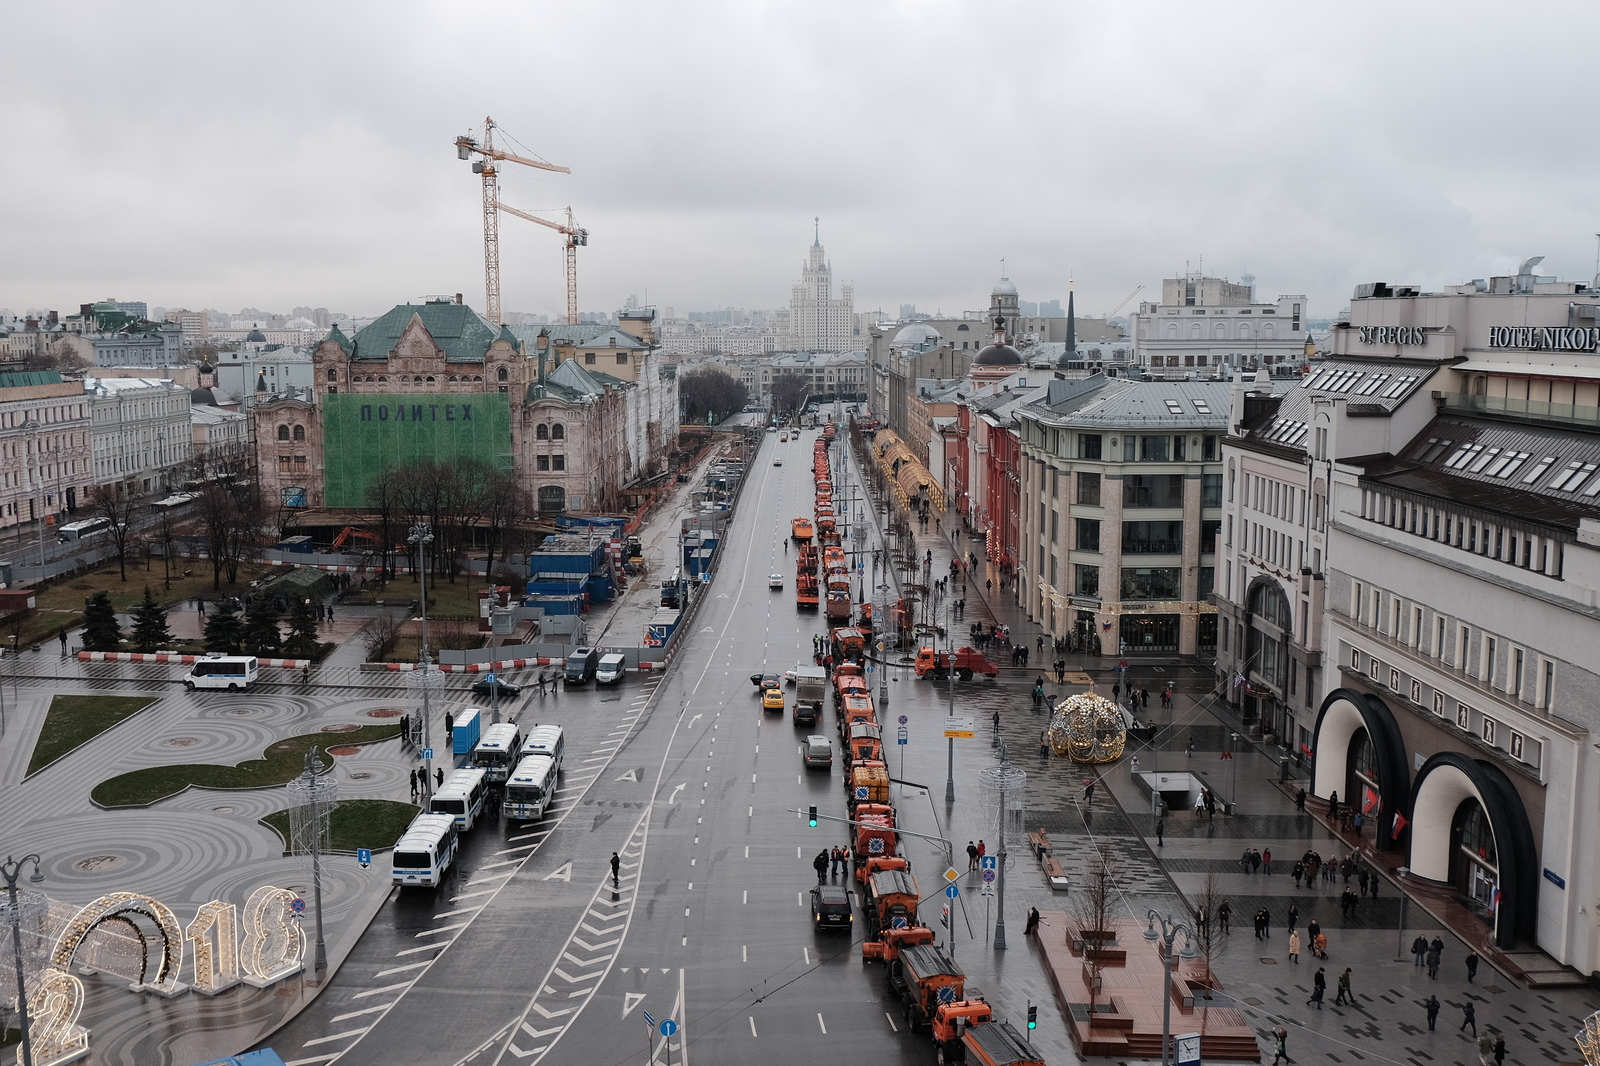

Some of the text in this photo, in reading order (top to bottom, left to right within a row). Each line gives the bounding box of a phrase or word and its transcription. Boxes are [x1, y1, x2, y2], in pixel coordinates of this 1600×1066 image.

[1378, 326, 1424, 345] REGIS
[1488, 327, 1537, 348] HOTEL
[360, 404, 472, 422] ПОЛИТЕХ
